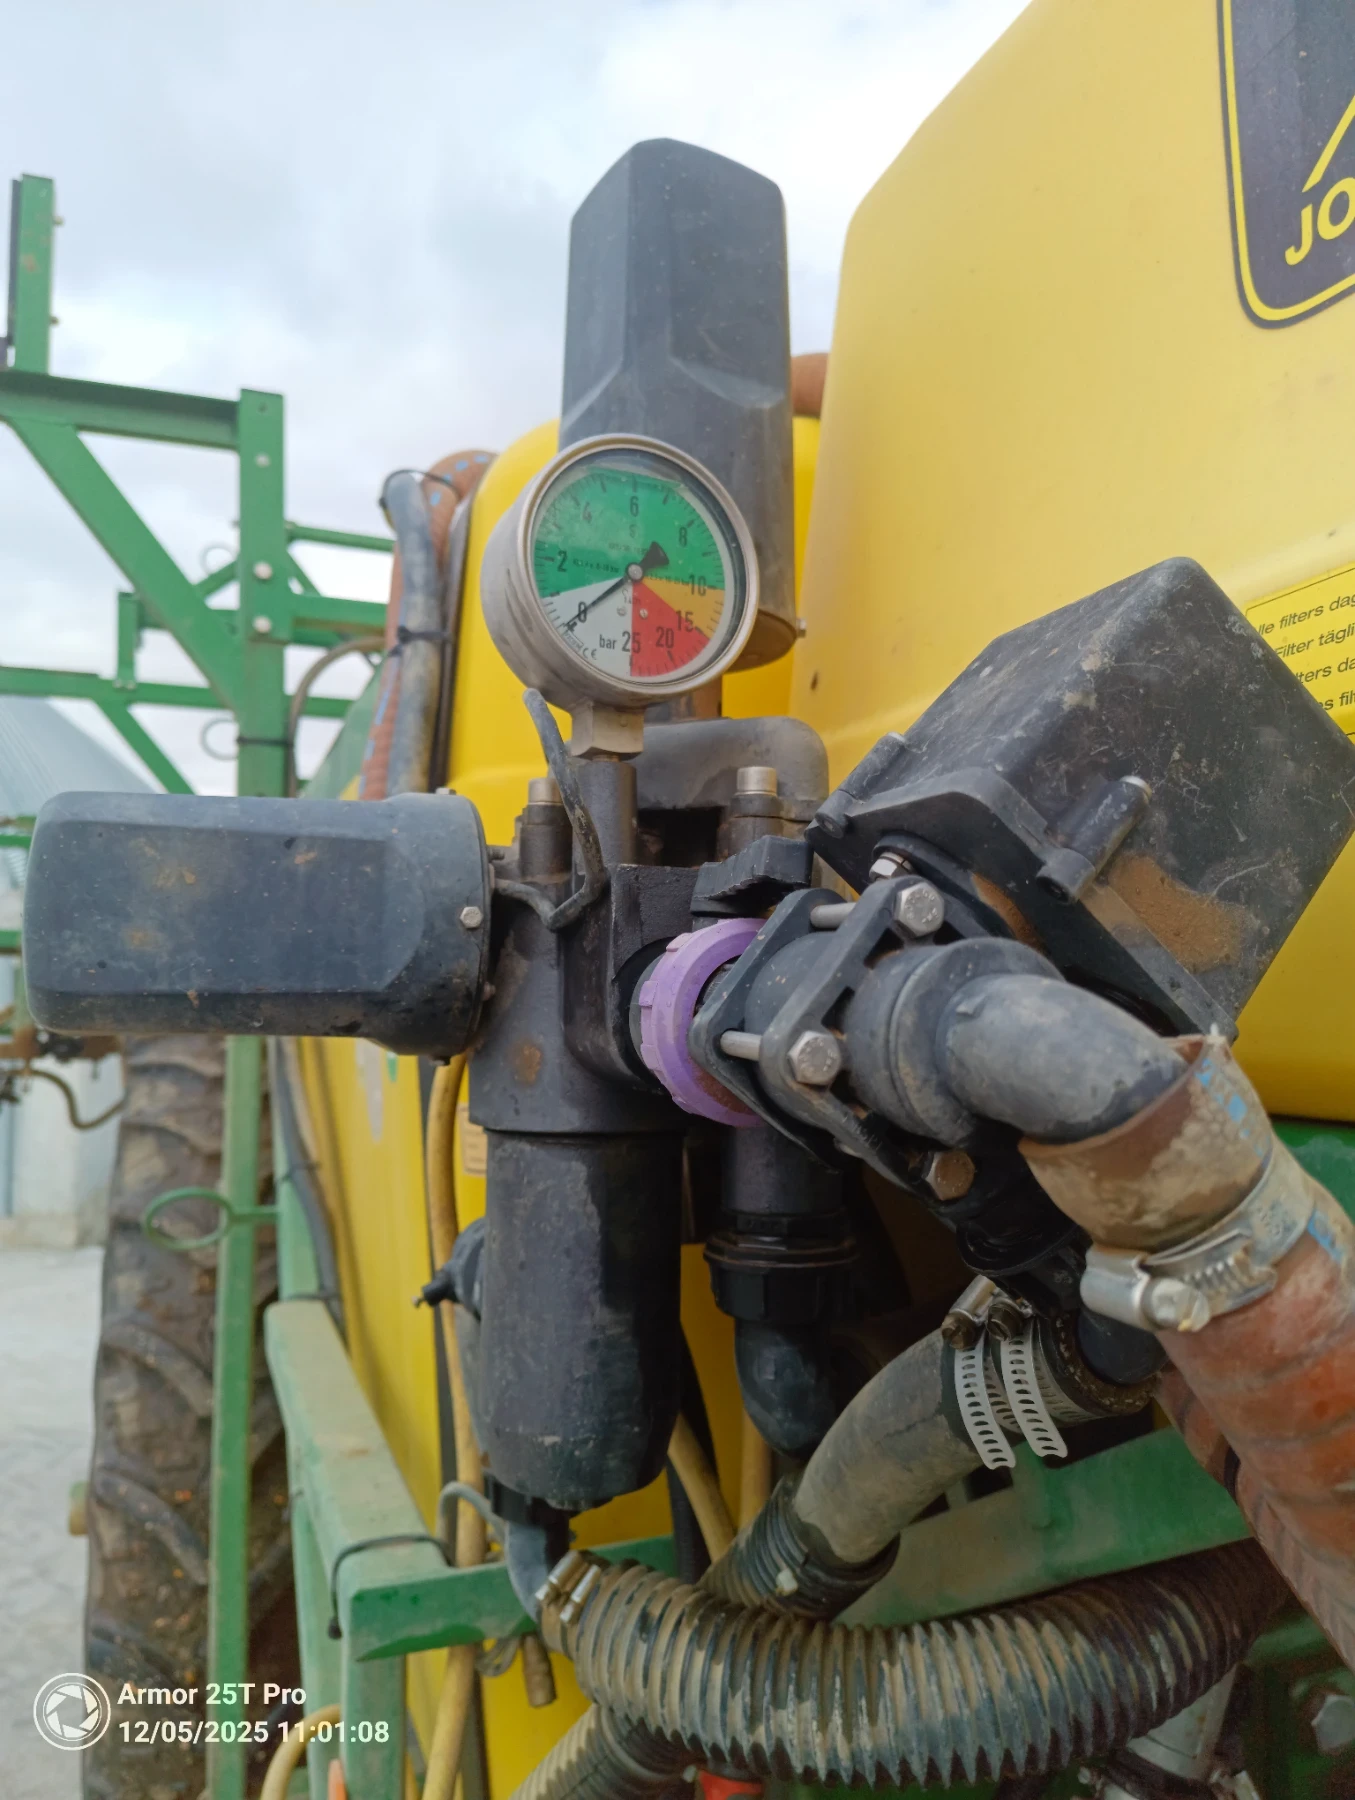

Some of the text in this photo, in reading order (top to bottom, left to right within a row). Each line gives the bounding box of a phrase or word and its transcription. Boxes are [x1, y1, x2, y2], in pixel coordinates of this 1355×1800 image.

[1285, 177, 1355, 265] JO
[582, 502, 593, 523] 4
[629, 495, 639, 517] 6
[678, 526, 688, 548] 8
[557, 550, 568, 573] 2
[688, 574, 707, 597] 10
[577, 602, 588, 623] 0
[675, 610, 694, 633] 15
[1258, 594, 1355, 636] lle filters dag
[599, 634, 617, 650] bar
[621, 630, 641, 654] 25
[655, 626, 675, 649] 20
[1319, 622, 1355, 647] tägli
[1296, 657, 1355, 684] ters da
